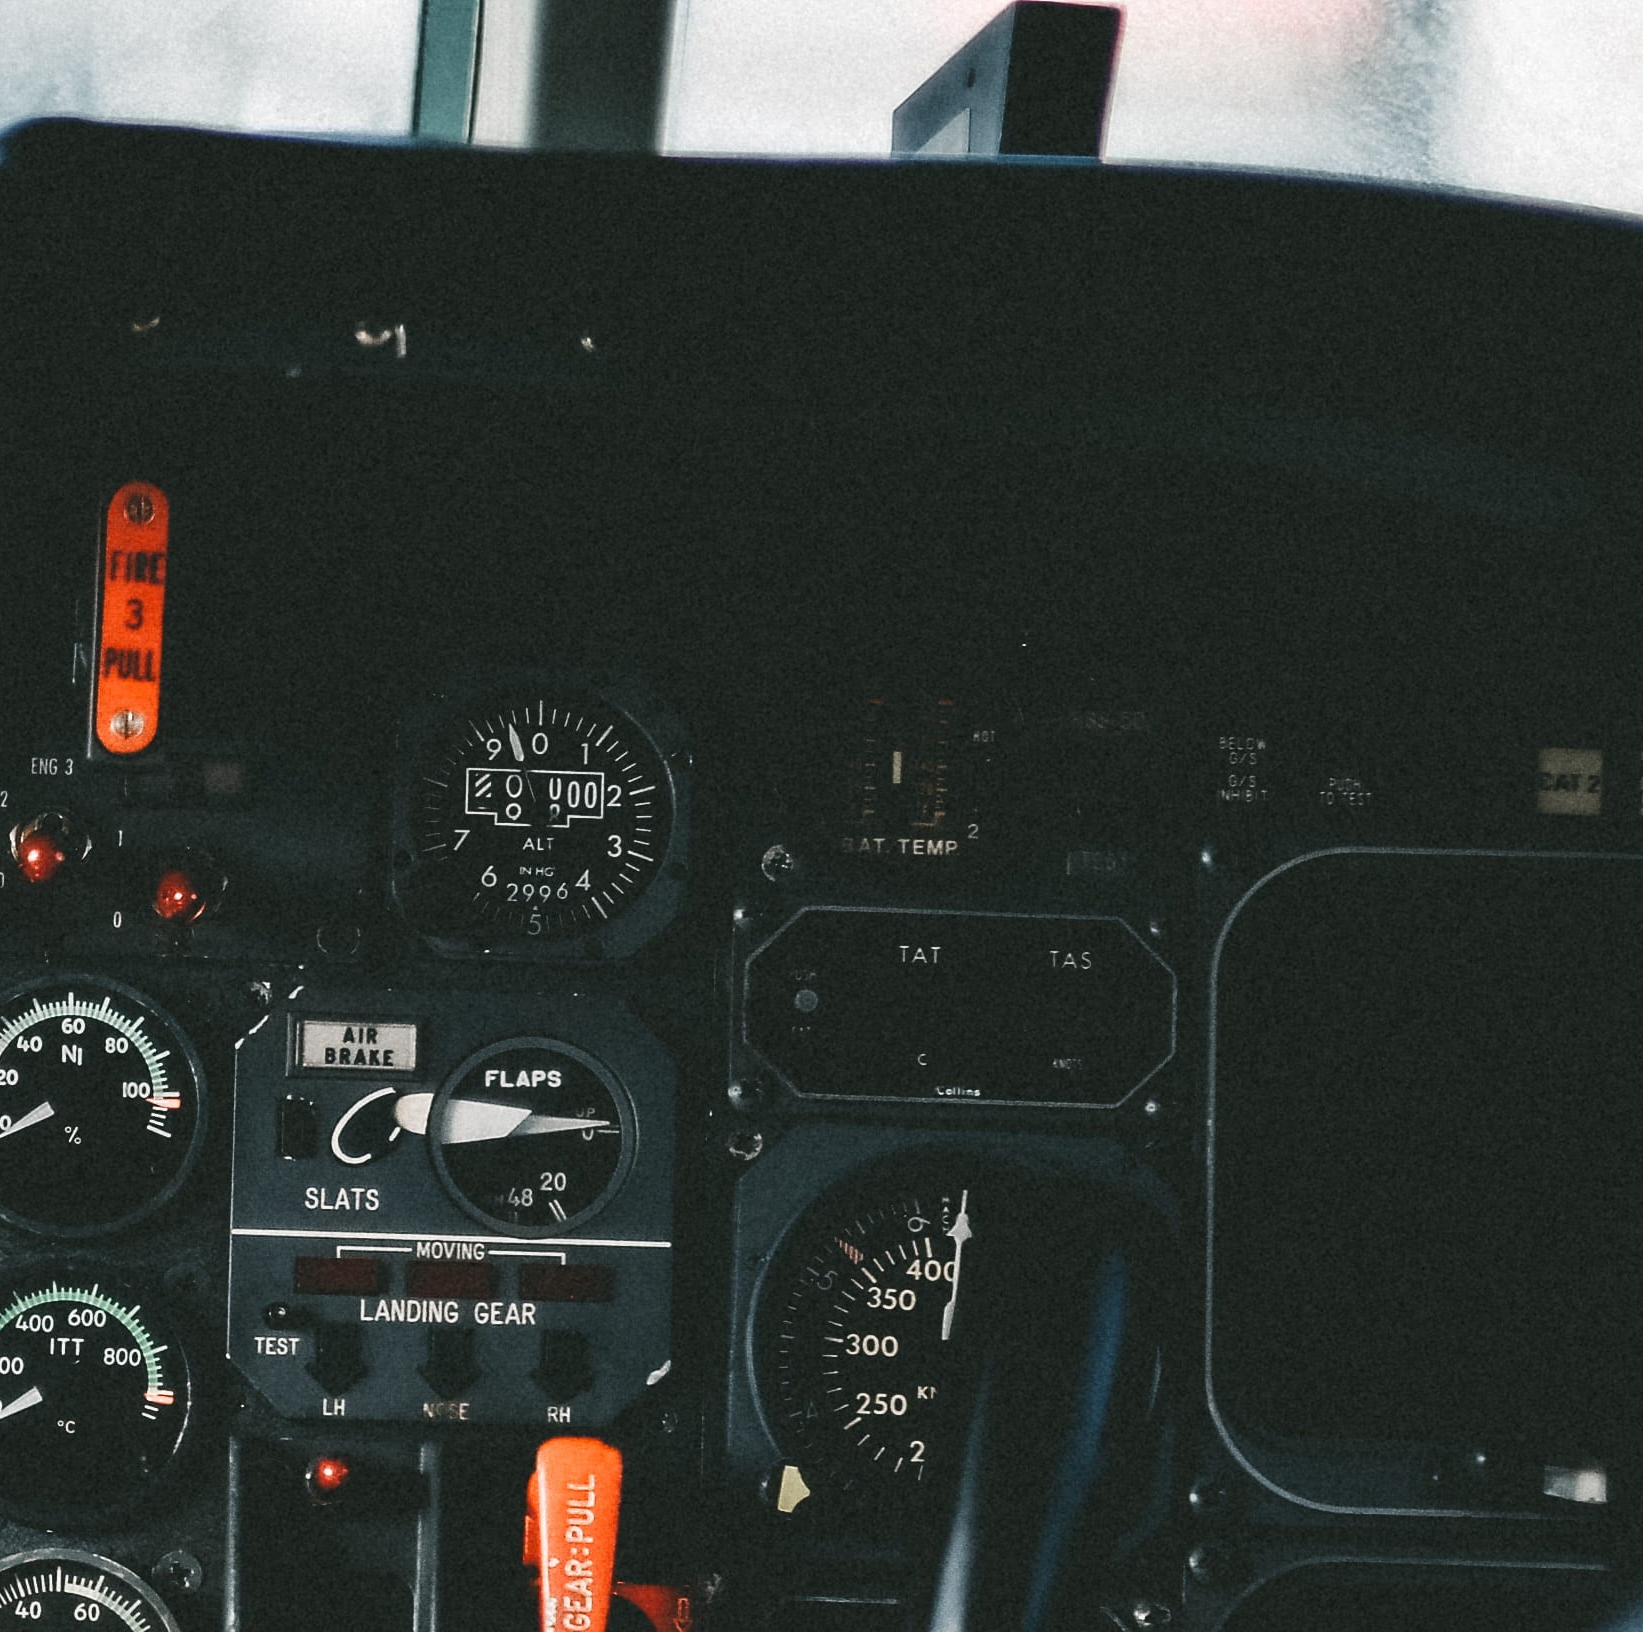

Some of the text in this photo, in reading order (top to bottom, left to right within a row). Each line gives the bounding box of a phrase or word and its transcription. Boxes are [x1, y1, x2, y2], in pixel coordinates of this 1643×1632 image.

[111, 552, 165, 586] FIRE
[125, 600, 144, 629] 3
[104, 648, 157, 681] PULL
[31, 758, 74, 775] ENG 3
[523, 838, 553, 851] ALT
[898, 945, 942, 965] TAT
[1049, 950, 1093, 970] TAS
[343, 1027, 377, 1044] AIR
[325, 1048, 394, 1067] BRAKE
[485, 1071, 561, 1088] FLAPS
[305, 1188, 379, 1211] SLATS
[417, 1242, 485, 1260] MOVING
[867, 1287, 916, 1311] 350
[360, 1300, 535, 1325] LANDING GEAR
[255, 1338, 299, 1354] TEST
[845, 1334, 898, 1356] 300
[323, 1399, 345, 1416] LH
[856, 1393, 906, 1415] 250
[548, 1407, 570, 1422] RH
